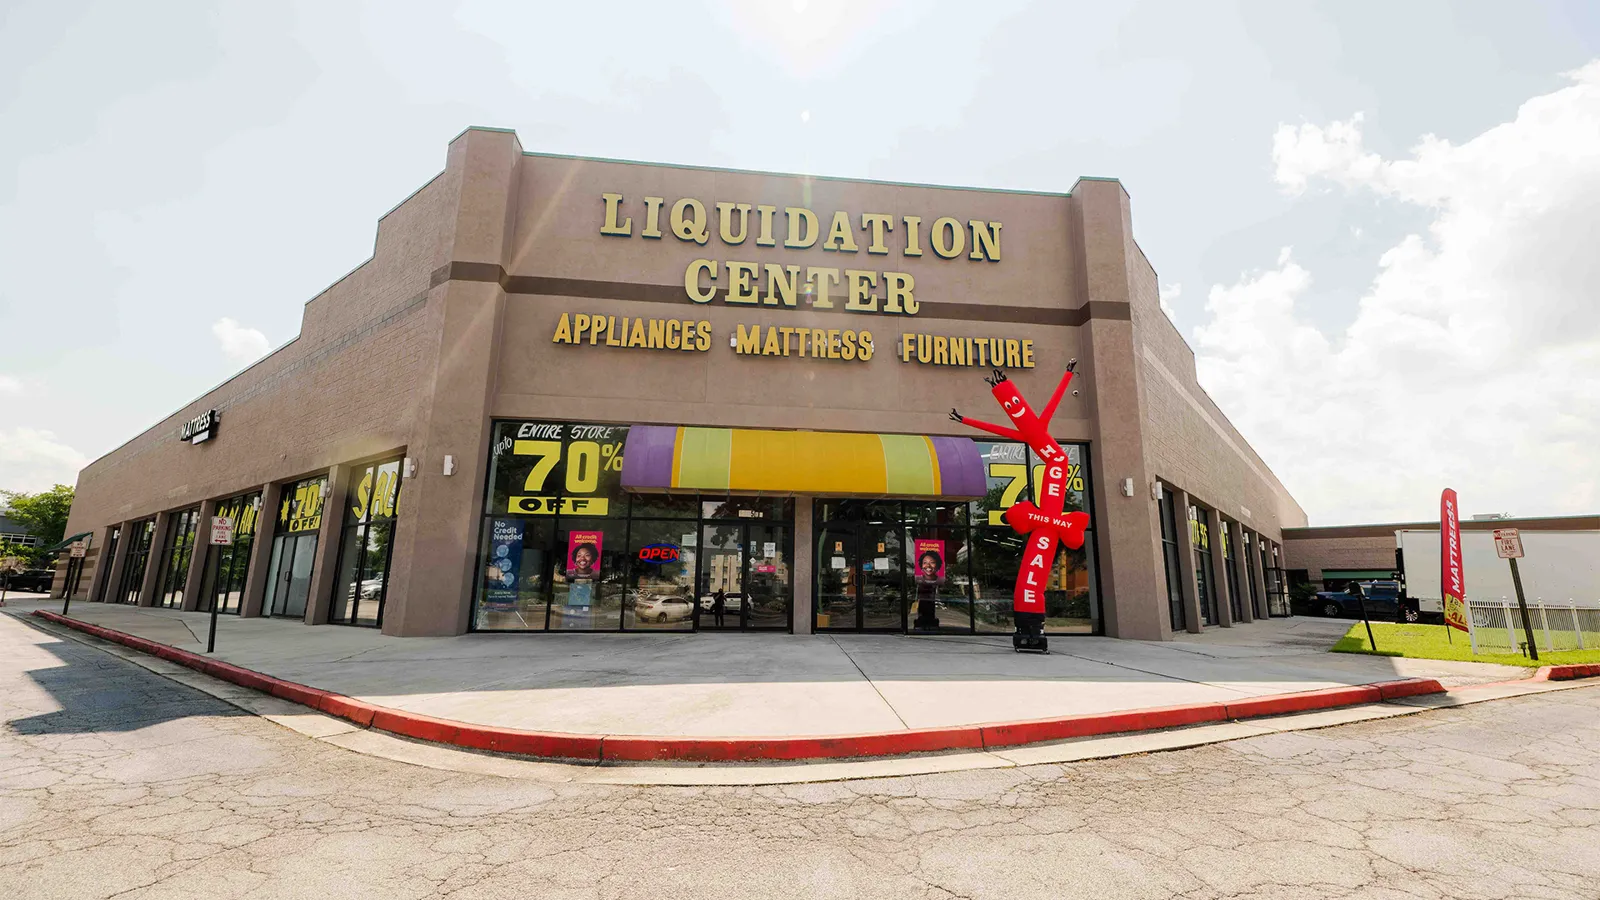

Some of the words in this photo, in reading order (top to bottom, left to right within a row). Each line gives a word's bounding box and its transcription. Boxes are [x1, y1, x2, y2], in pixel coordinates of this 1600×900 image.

[600, 192, 1002, 262] LIQUIDATION
[684, 258, 919, 315] CENTER
[552, 312, 712, 353] APPLIANCES
[736, 324, 873, 362] MATTRESS
[902, 333, 1036, 369] FURNITURE
[180, 409, 212, 440] MATTRESS
[517, 423, 563, 439] ENTIRE
[570, 425, 615, 440] STORE
[513, 440, 624, 493] 70%
[518, 498, 590, 512] OFF
[1027, 513, 1050, 523] THIS
[1052, 518, 1073, 529] WAY
[639, 547, 681, 560] OPEN
[1023, 536, 1050, 603] SALE
